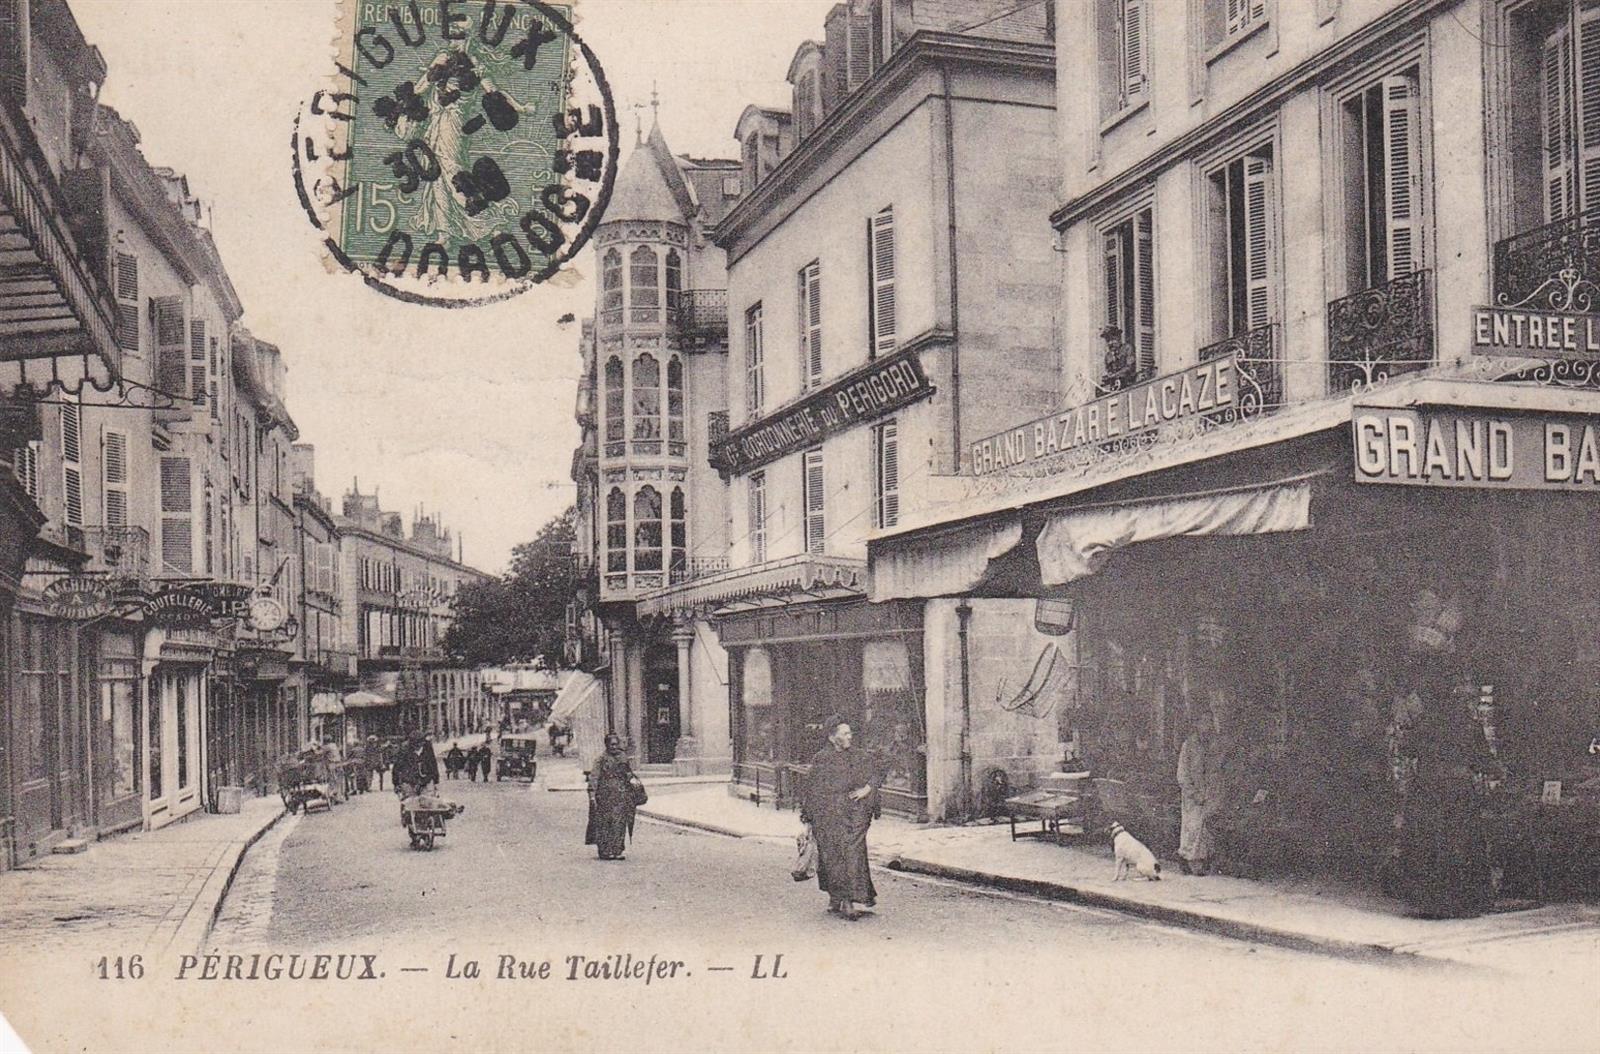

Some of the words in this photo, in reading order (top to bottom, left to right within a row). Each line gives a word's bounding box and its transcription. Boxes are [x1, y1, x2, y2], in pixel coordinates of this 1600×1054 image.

[1475, 312, 1577, 350] ENTREE
[741, 407, 819, 460] CORDONNERIE
[821, 404, 839, 427] DU
[835, 358, 921, 419] PERIGORD
[971, 428, 1026, 477] GRAND
[1127, 359, 1233, 431] LACAZE
[1355, 414, 1515, 481] GRAND
[142, 592, 212, 617] COUTELLERIE
